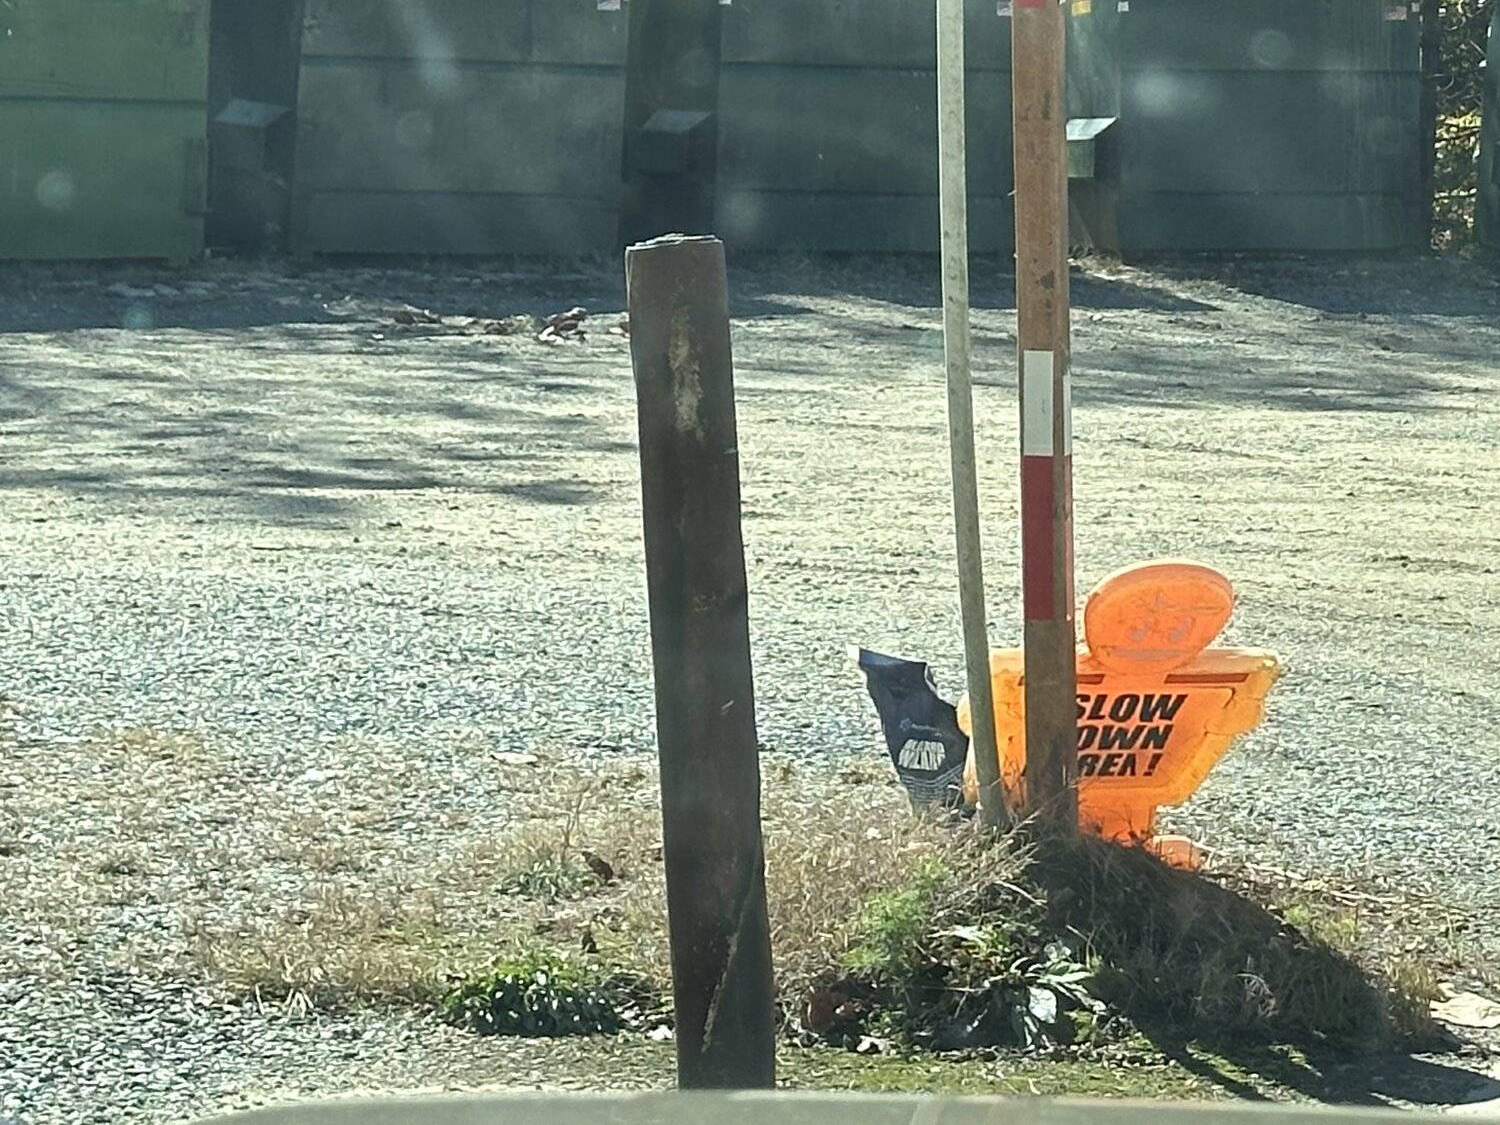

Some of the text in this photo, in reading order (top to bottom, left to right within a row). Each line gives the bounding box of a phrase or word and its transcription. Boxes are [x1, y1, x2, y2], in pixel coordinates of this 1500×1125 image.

[1076, 694, 1188, 723] SLOW
[1077, 724, 1174, 750] OWN
[1077, 753, 1164, 777] REA!
